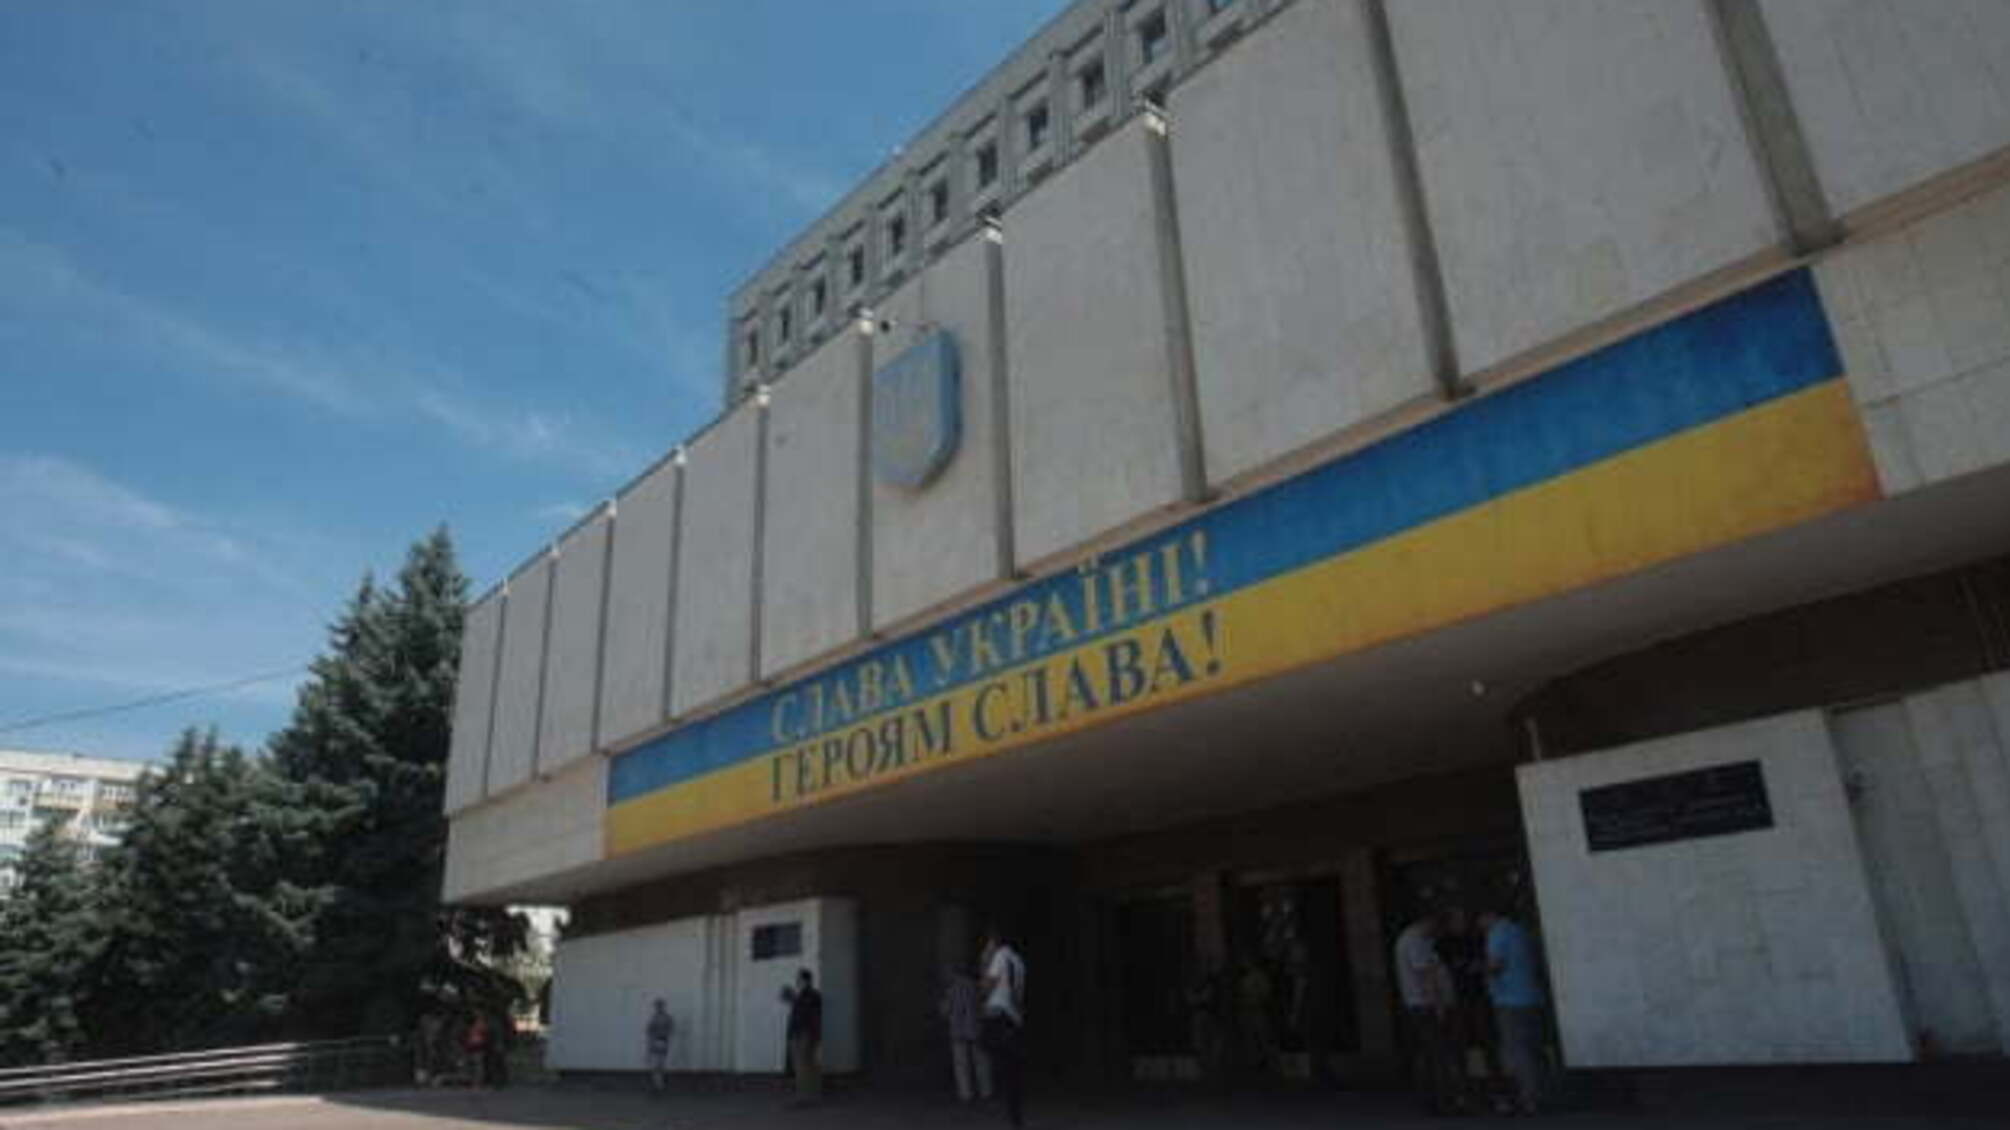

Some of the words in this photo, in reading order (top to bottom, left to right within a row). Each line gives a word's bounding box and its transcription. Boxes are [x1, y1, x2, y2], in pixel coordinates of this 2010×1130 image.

[771, 647, 915, 745] СЛАВА
[929, 530, 1210, 685] УКРАЇНІ!
[771, 702, 954, 802] ГЕРОЯМ
[973, 610, 1223, 742] СЛАВА!
